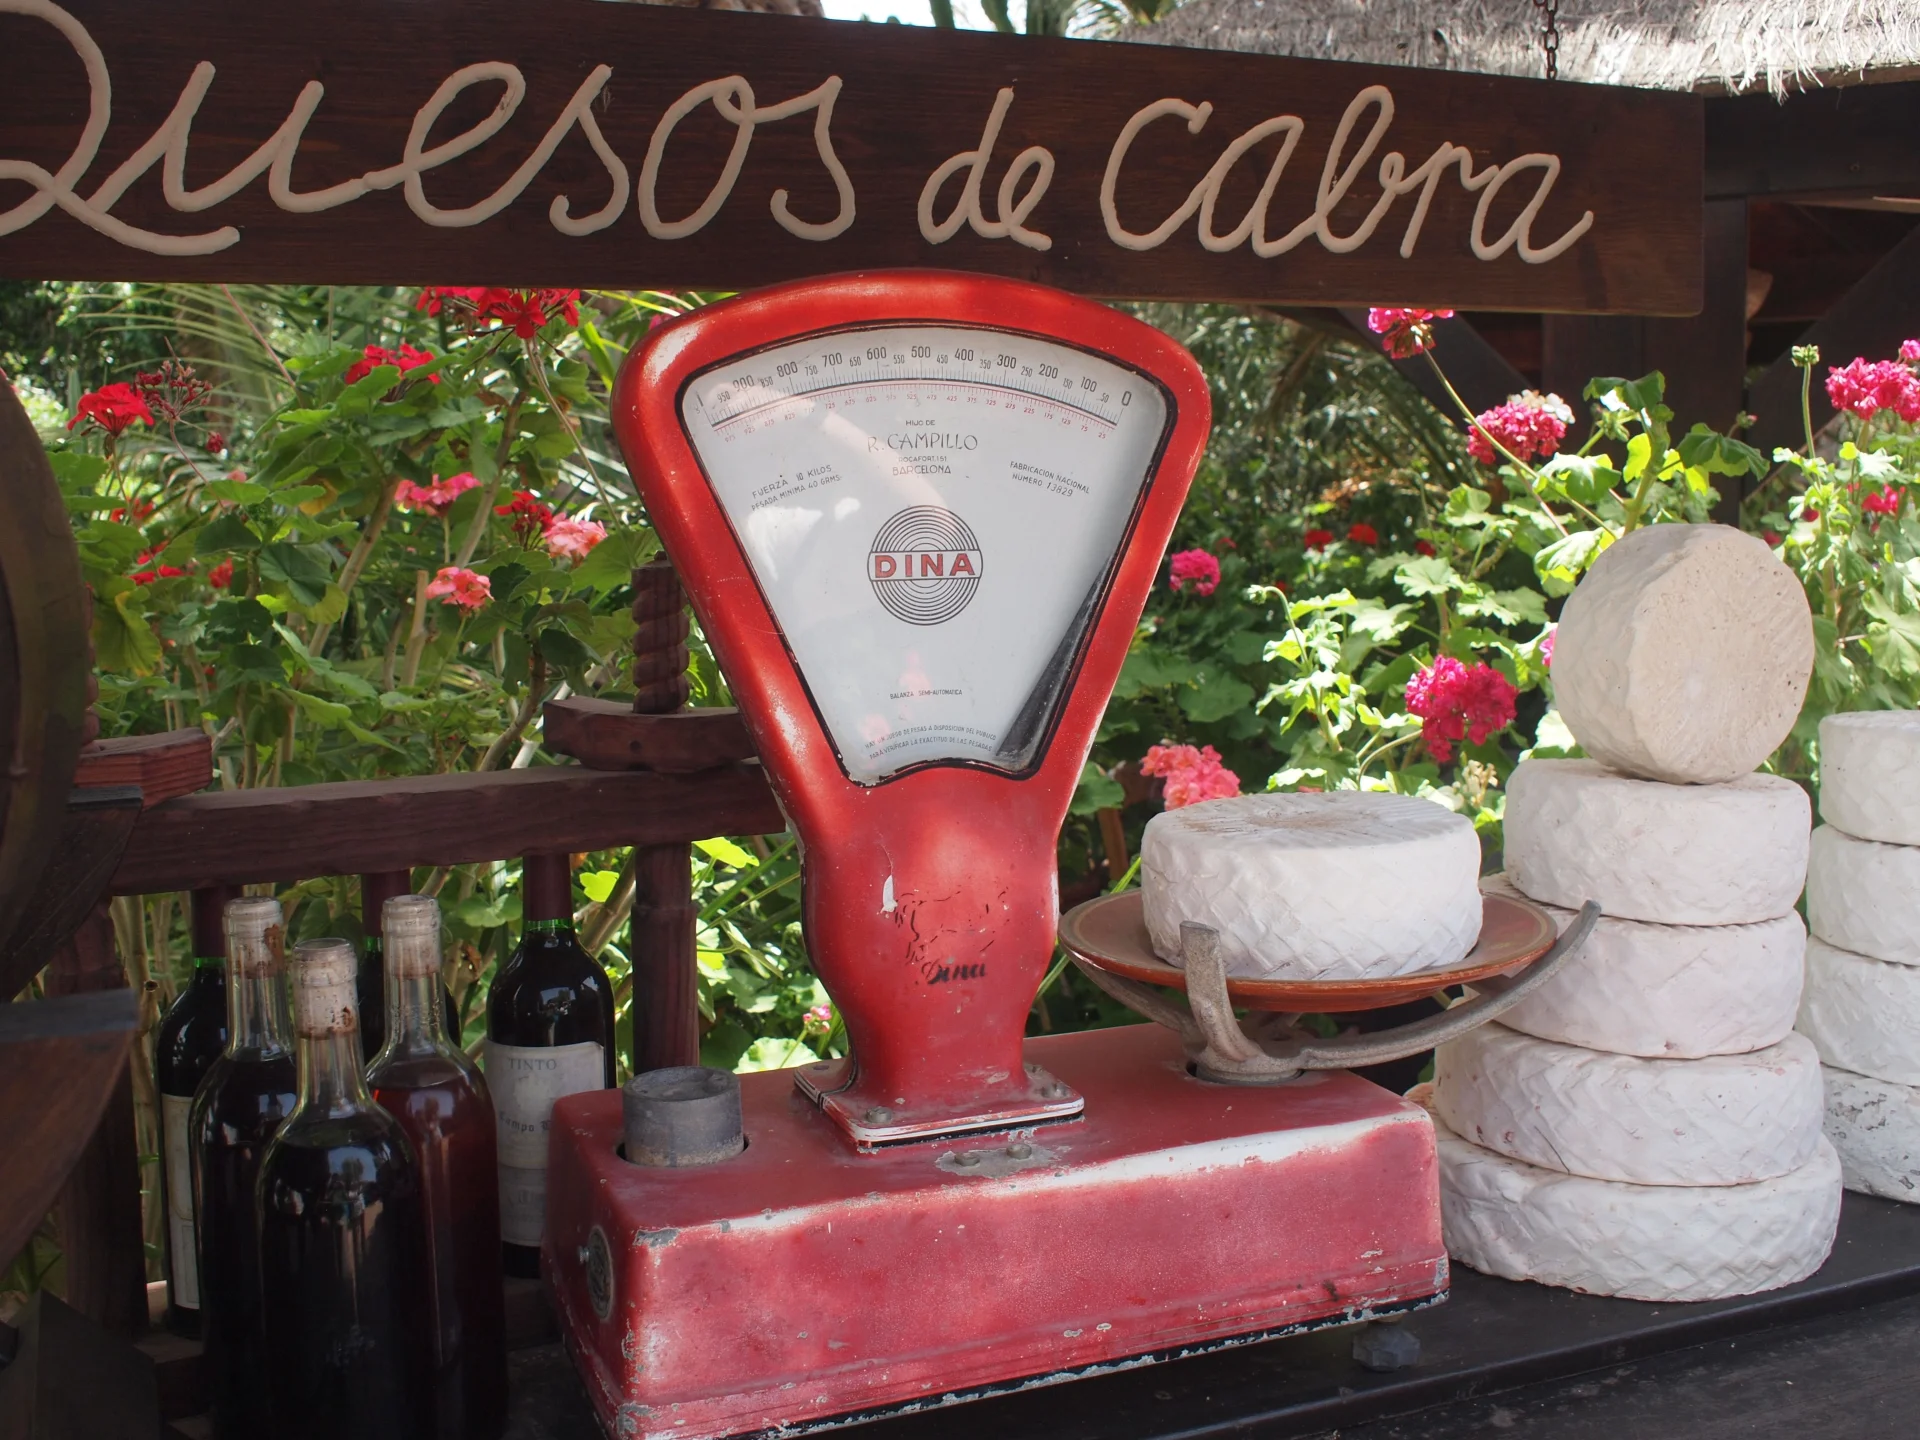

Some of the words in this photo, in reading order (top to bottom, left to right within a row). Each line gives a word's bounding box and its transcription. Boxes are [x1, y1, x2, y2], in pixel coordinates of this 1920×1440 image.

[918, 87, 1055, 250] de
[1100, 85, 1594, 264] Cabra
[717, 390, 730, 403] 950
[732, 374, 754, 392] 900
[760, 376, 774, 388] 850
[776, 361, 798, 378] 800
[804, 364, 818, 376] 750
[822, 352, 843, 368] 700
[850, 356, 862, 367] 650
[866, 346, 887, 360] 600
[893, 354, 905, 364] 550
[911, 346, 931, 358] 500
[936, 354, 948, 364] 450
[954, 348, 974, 361] 400
[980, 358, 992, 370] 350
[996, 354, 1016, 369] 300
[1020, 366, 1032, 378] 250
[1038, 363, 1058, 379] 200
[1062, 378, 1073, 390] 150
[1080, 376, 1098, 392] 100
[1100, 392, 1110, 403] 50
[1121, 390, 1132, 406] 0
[744, 427, 756, 436] 925
[784, 412, 796, 420] 825
[825, 402, 836, 410] 725
[1044, 412, 1053, 420] 175
[868, 436, 884, 452] R.
[887, 432, 978, 450] CAMPILLO
[752, 479, 788, 499] FUERZA
[796, 472, 804, 481] 10
[808, 464, 832, 478] KILOS
[892, 464, 952, 476] BARCELONA
[1010, 461, 1054, 480] FABRICACION
[1056, 474, 1090, 494] NACIONAL
[751, 495, 778, 512] PESADA
[780, 484, 806, 499] MINIMA
[808, 480, 818, 489] 40
[1012, 473, 1042, 486] NUMERO
[1046, 482, 1074, 497] 13829
[874, 553, 976, 578] DINA
[890, 691, 914, 700] BALANZA
[934, 724, 964, 732] DISPOSICION
[508, 1058, 558, 1070] TINTO
